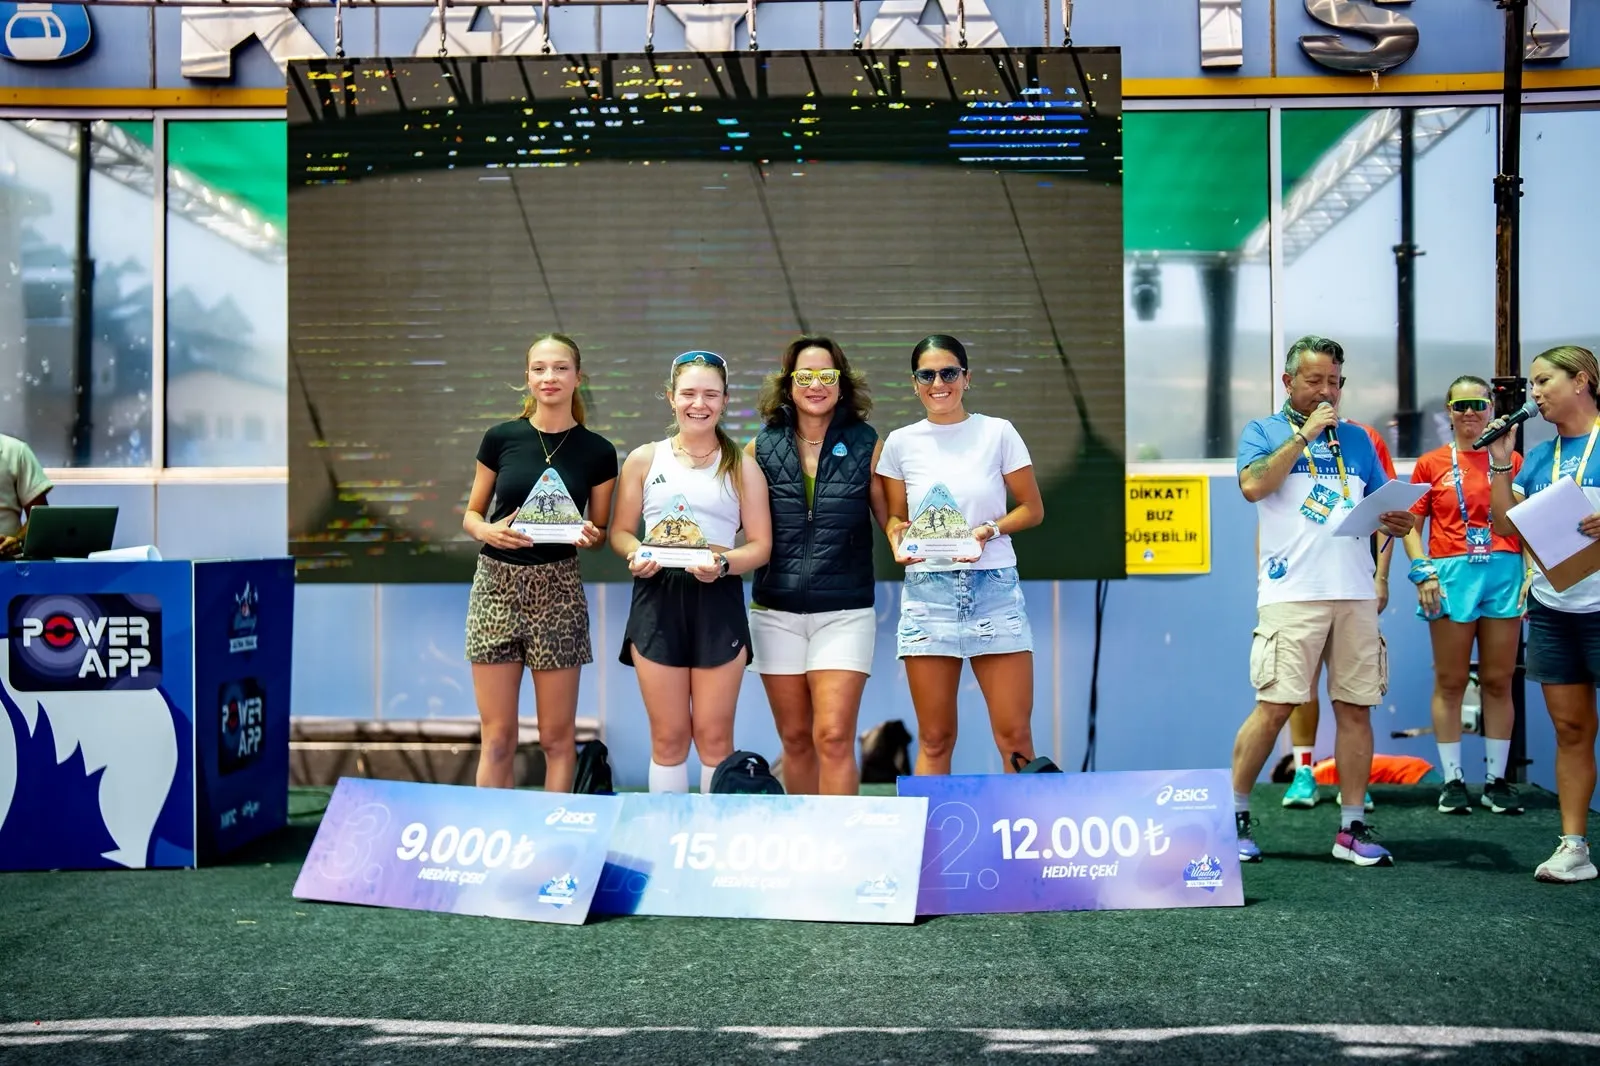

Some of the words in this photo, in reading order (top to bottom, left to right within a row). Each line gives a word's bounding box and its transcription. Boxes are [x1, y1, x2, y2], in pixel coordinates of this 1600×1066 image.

[1130, 485, 1189, 499] DİKKAT!
[1146, 509, 1173, 521] BUZ
[23, 616, 149, 647] POWER
[78, 649, 151, 678] APP
[238, 726, 262, 757] APP
[919, 801, 999, 890] 2.
[1042, 863, 1089, 879] HEDİYE
[1090, 861, 1119, 879] ÇEKİ
